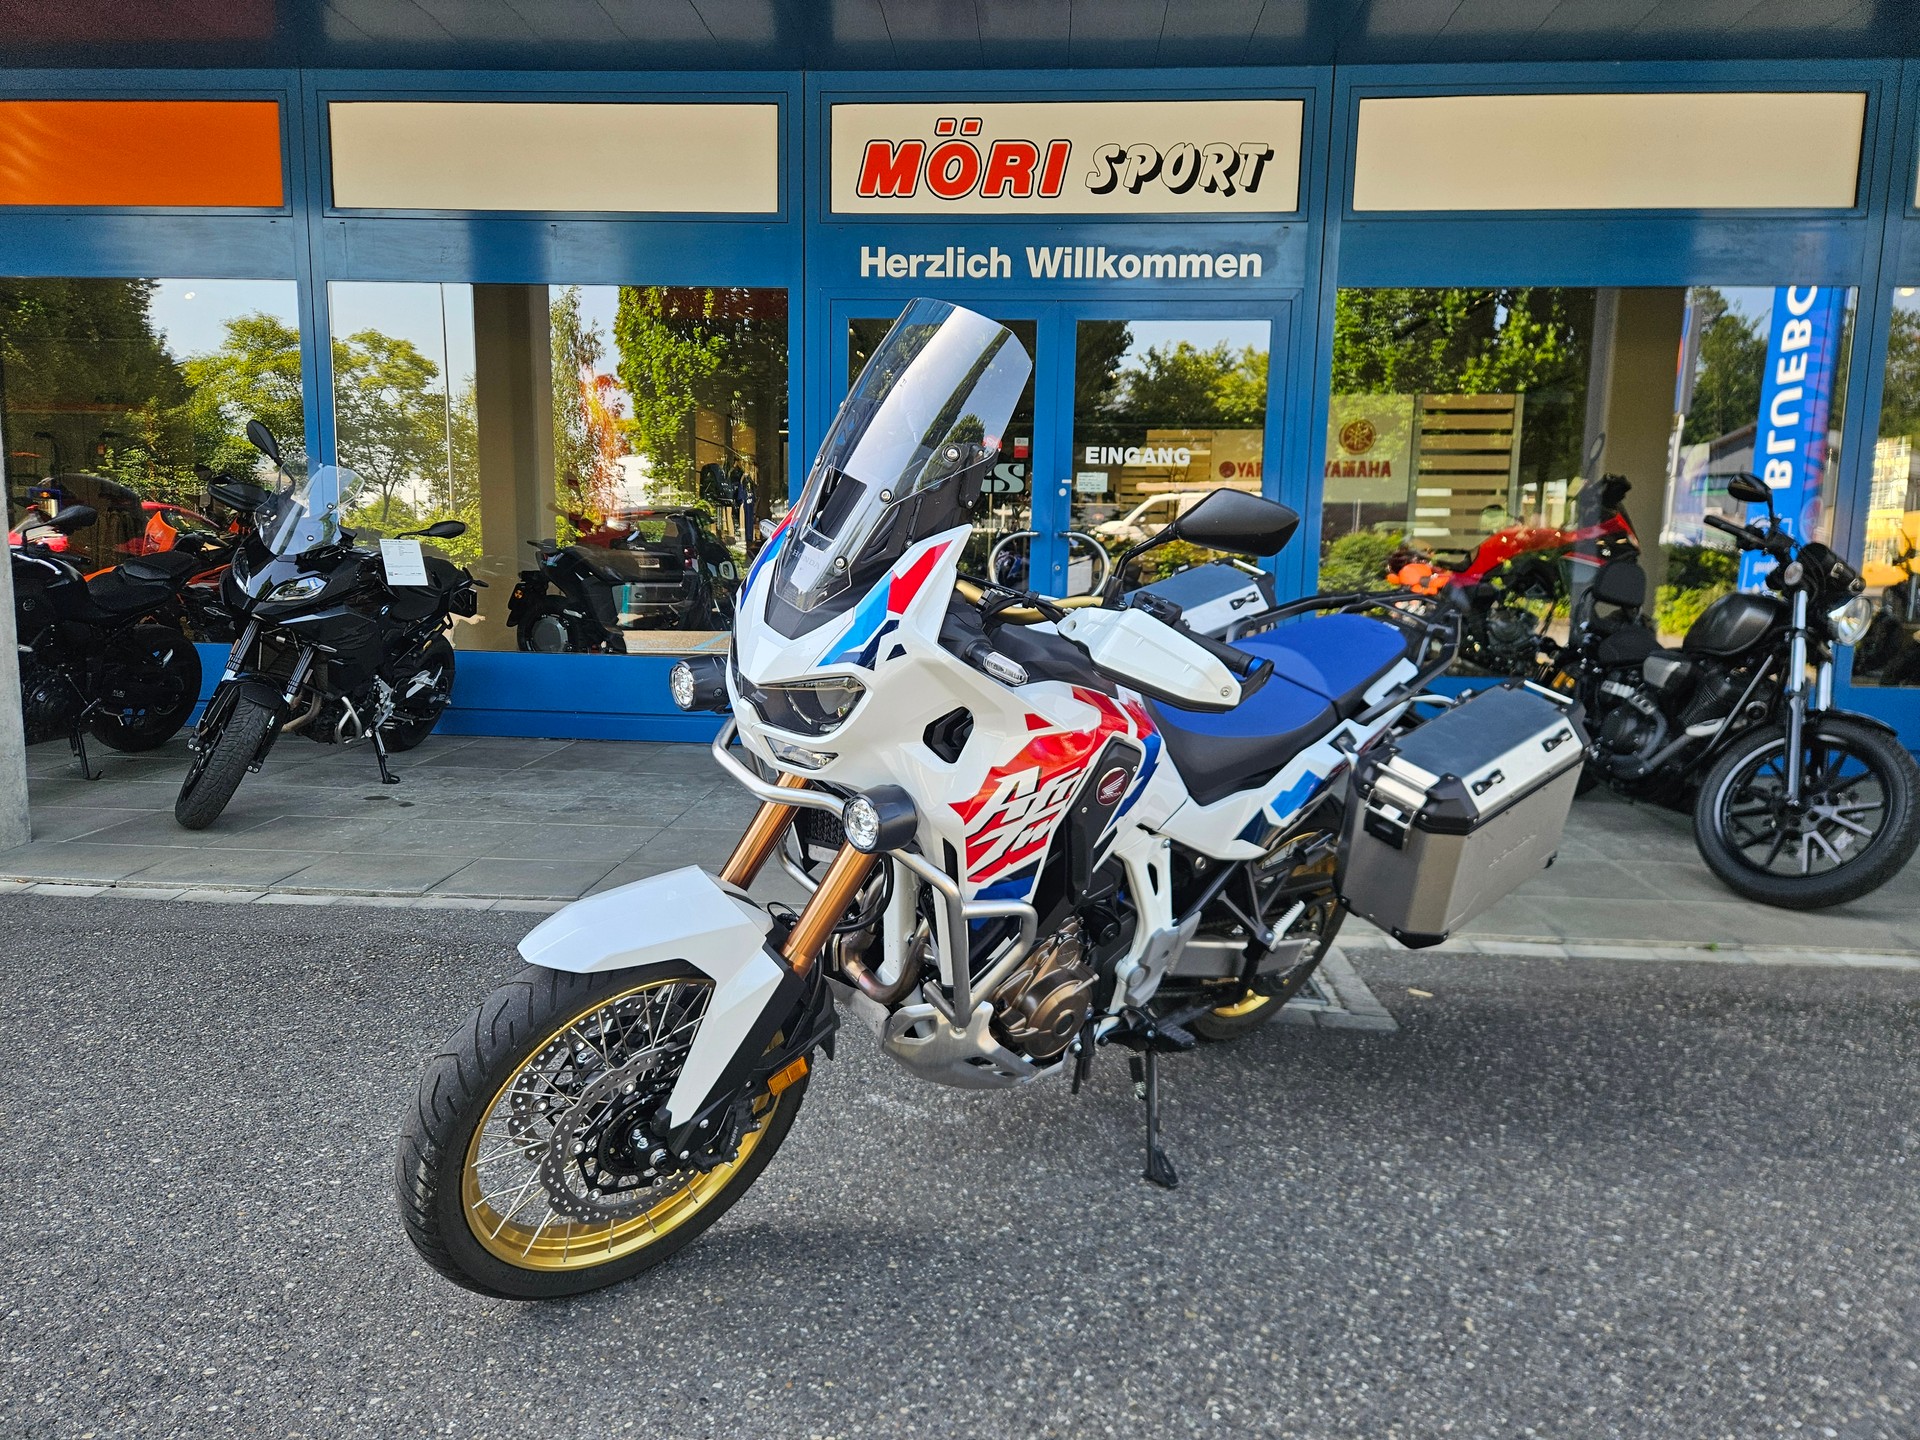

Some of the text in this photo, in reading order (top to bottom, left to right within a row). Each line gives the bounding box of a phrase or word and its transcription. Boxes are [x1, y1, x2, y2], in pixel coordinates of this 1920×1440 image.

[856, 117, 1274, 200] MÖRI SPORT
[860, 246, 1263, 278] Herzlich Willkommen
[1085, 446, 1191, 465] EINGANG
